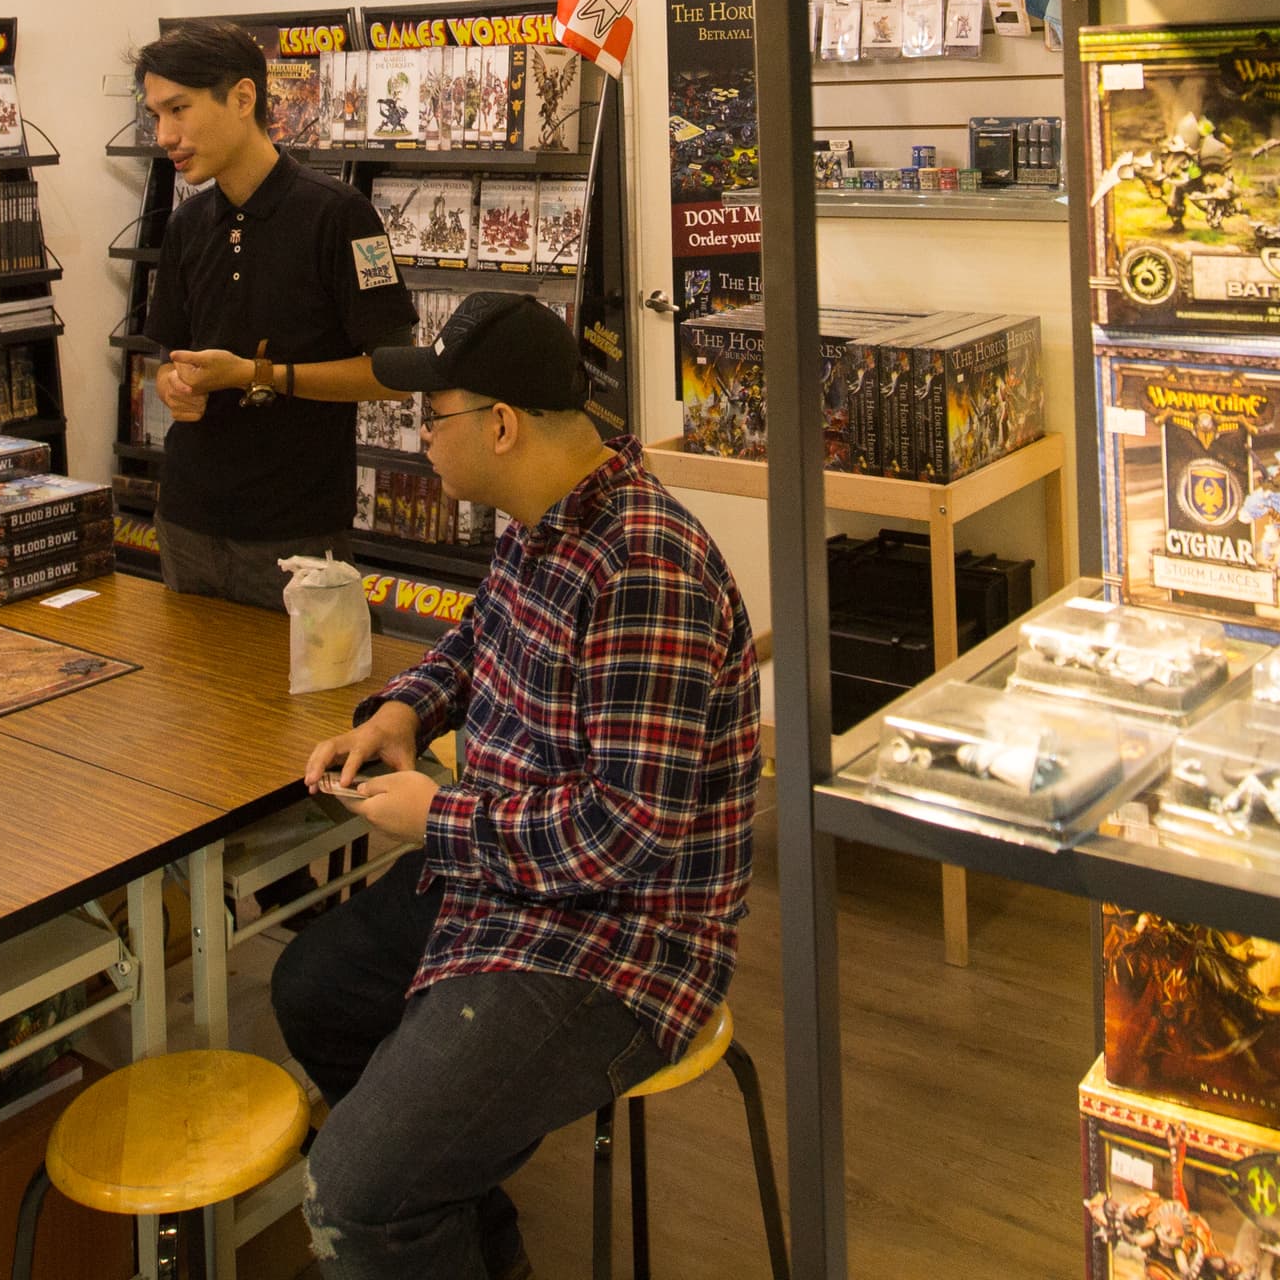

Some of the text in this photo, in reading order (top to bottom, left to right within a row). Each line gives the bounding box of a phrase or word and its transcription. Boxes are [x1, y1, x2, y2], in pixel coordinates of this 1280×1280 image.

[671, 3, 705, 23] THE
[278, 23, 347, 56] KSHOP
[369, 13, 558, 51] GAMES WORKSH
[698, 27, 753, 41] BETRAYAL
[684, 205, 761, 227] DON'T M
[688, 230, 761, 248] Order your
[719, 273, 745, 291] THE
[691, 328, 766, 352] THE HOR
[951, 350, 973, 370] THE
[974, 340, 1006, 364] HORUS
[1006, 328, 1037, 352] HERESY
[10, 501, 77, 527] BLOOD BOWL
[13, 530, 79, 557] BLOOD BOWL
[1166, 529, 1257, 566] CYGNAR
[13, 561, 79, 590] BLOOD BOWL
[1165, 562, 1207, 579] STORM
[1209, 568, 1260, 588] LANCES
[361, 572, 476, 624] ES WORK
